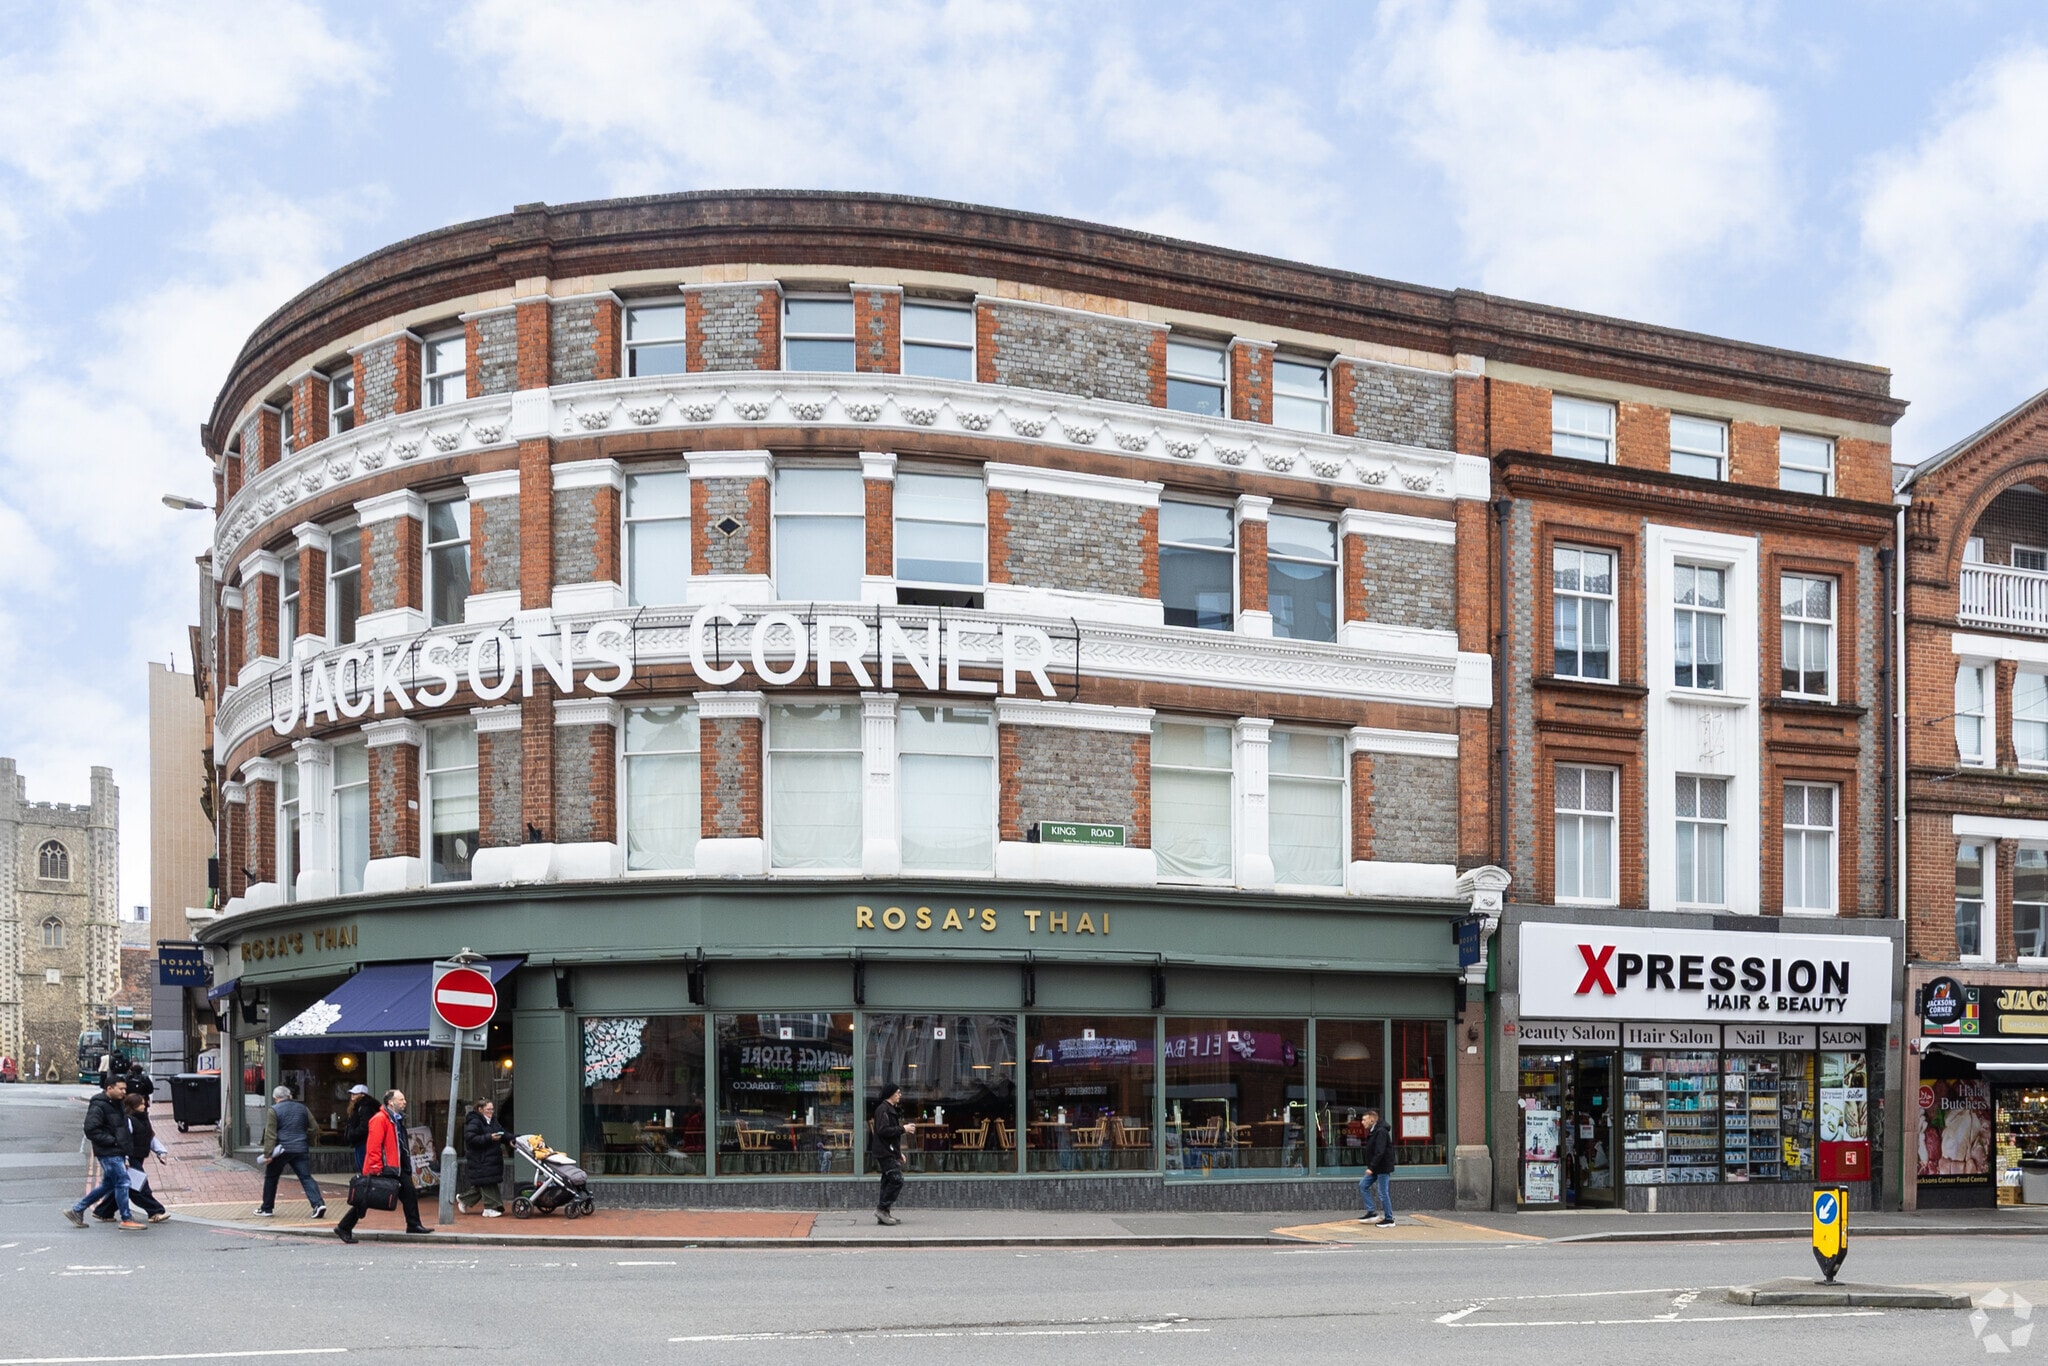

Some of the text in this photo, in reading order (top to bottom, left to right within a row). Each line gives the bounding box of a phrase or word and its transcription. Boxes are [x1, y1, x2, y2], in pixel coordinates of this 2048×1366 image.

[272, 602, 1057, 736] JACKSONS CORNER
[1051, 826, 1115, 838] KINGS ROAD
[856, 905, 1110, 935] ROSA'S THAI
[241, 925, 358, 962] ROSA'S THAI
[161, 958, 202, 967] ROSA'S
[169, 967, 196, 977] THAI
[1574, 944, 1850, 996] XPRESSION
[1706, 994, 1848, 1013] HAIR & BEAUTY
[1926, 999, 1957, 1008] JACKSONS
[1997, 989, 2048, 1011] JAC
[1929, 1006, 1953, 1014] CORNER
[1518, 1025, 1568, 1042] Beauty
[1572, 1025, 1616, 1041] Salon
[1629, 1028, 1714, 1044] Hair Salon
[1735, 1030, 1804, 1046] Nail Bar
[1822, 1031, 1863, 1044] SALON
[383, 1038, 430, 1048] ROSA'S THA
[1959, 1084, 1986, 1097] Halal
[1941, 1097, 1988, 1110] Butchers
